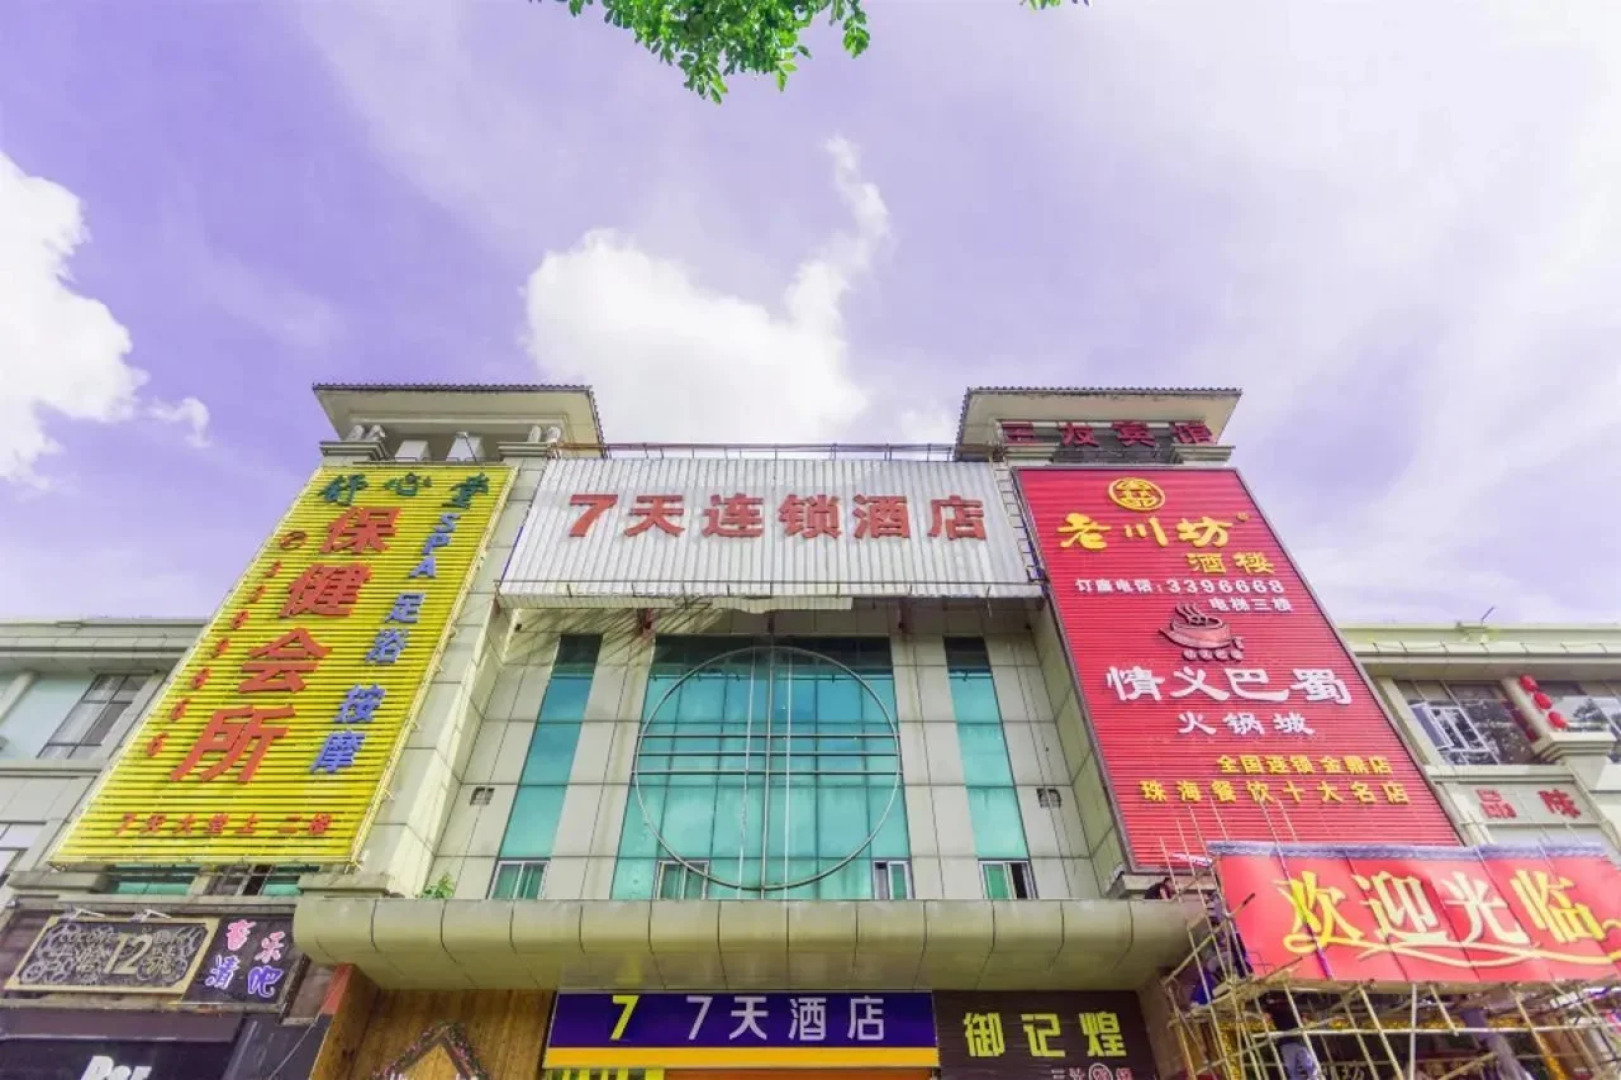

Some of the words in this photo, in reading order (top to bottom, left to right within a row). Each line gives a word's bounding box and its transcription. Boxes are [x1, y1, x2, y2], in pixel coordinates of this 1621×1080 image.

[568, 493, 987, 541] 7天连锁酒店
[1058, 513, 1232, 549] 老川坊
[409, 513, 461, 579] SPA
[1186, 552, 1275, 575] 酒楼
[169, 506, 401, 785] 保健会所
[1106, 665, 1352, 705] 情义巴蜀
[1178, 711, 1316, 736] 火锅城
[1139, 779, 1411, 804] 珠海餐饮十大名店
[1273, 869, 1607, 948] 欢迎光临
[686, 995, 885, 1041] 7天酒店
[964, 1011, 1127, 1057] 御记煌
